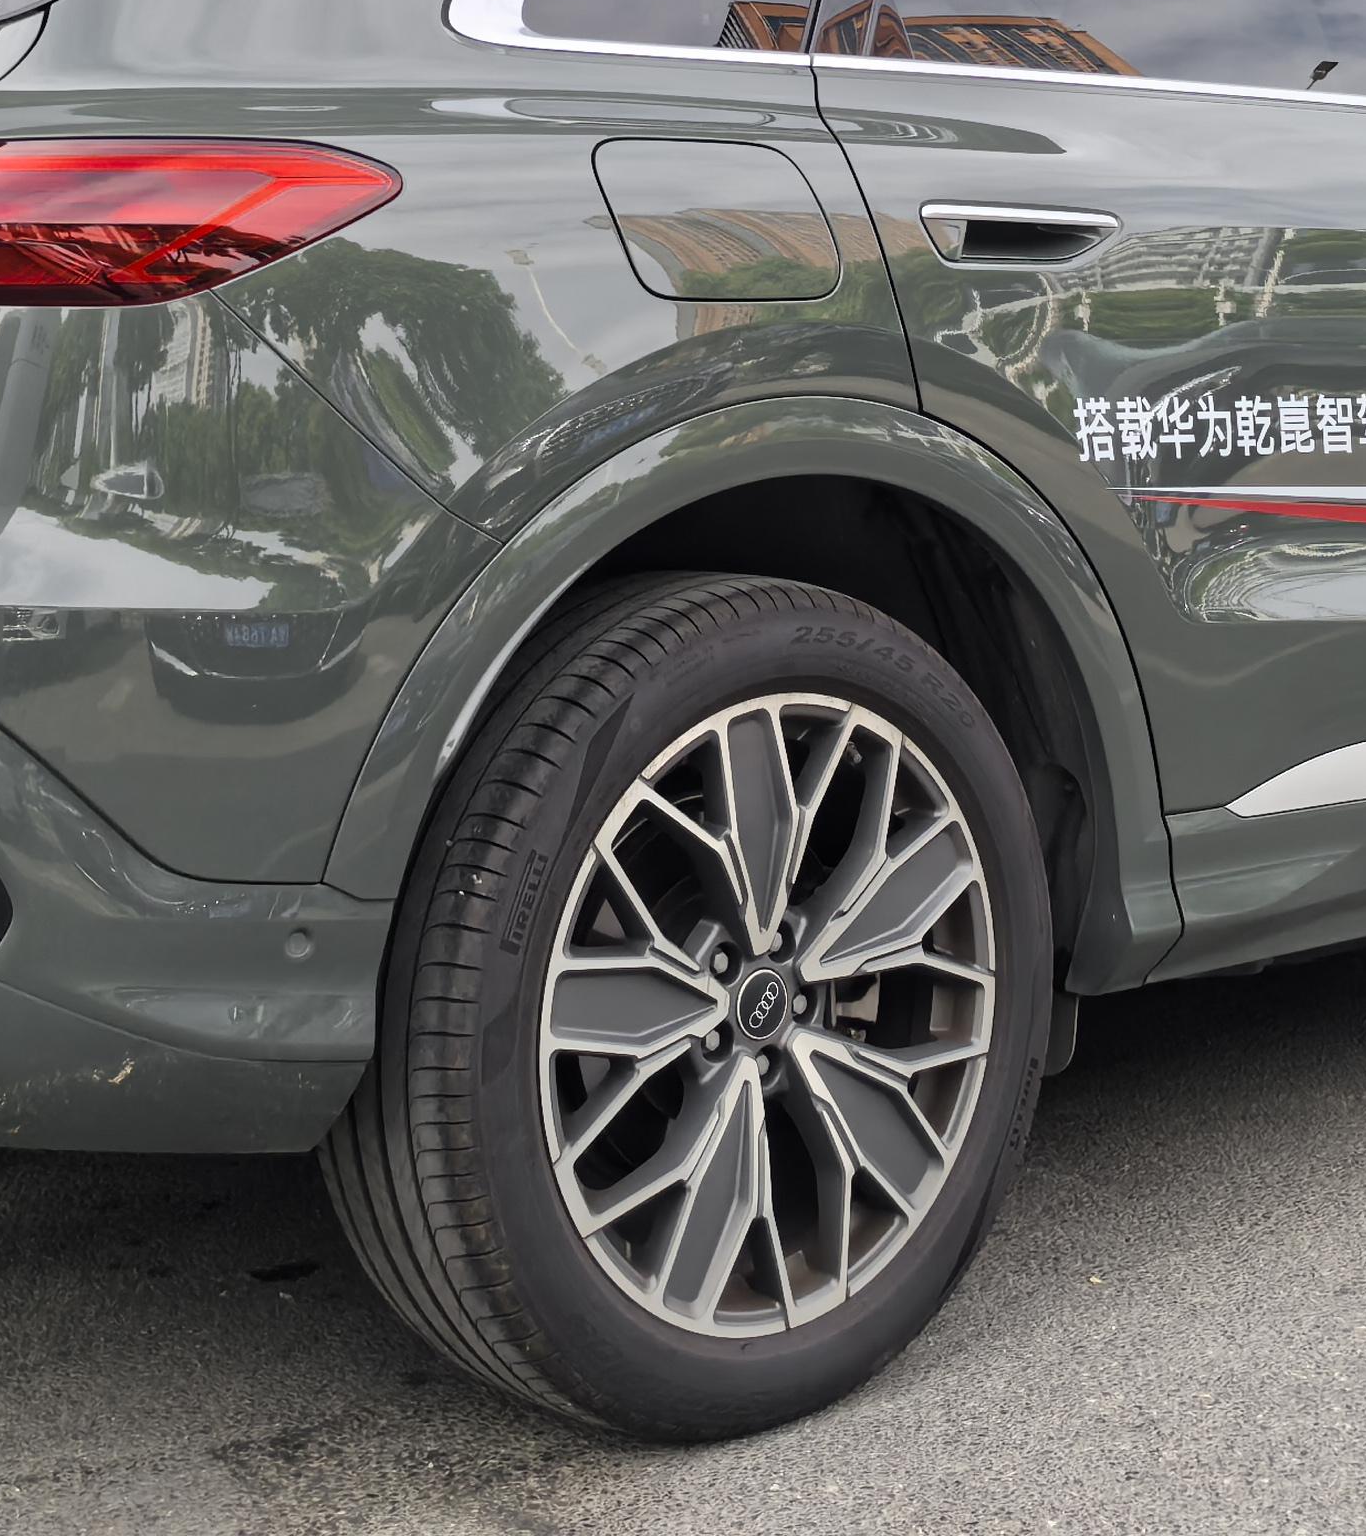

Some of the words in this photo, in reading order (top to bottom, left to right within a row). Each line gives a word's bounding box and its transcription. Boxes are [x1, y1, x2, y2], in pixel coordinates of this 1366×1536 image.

[791, 625, 916, 673] 255/45
[921, 671, 976, 729] R20
[498, 849, 549, 956] PIRELLI
